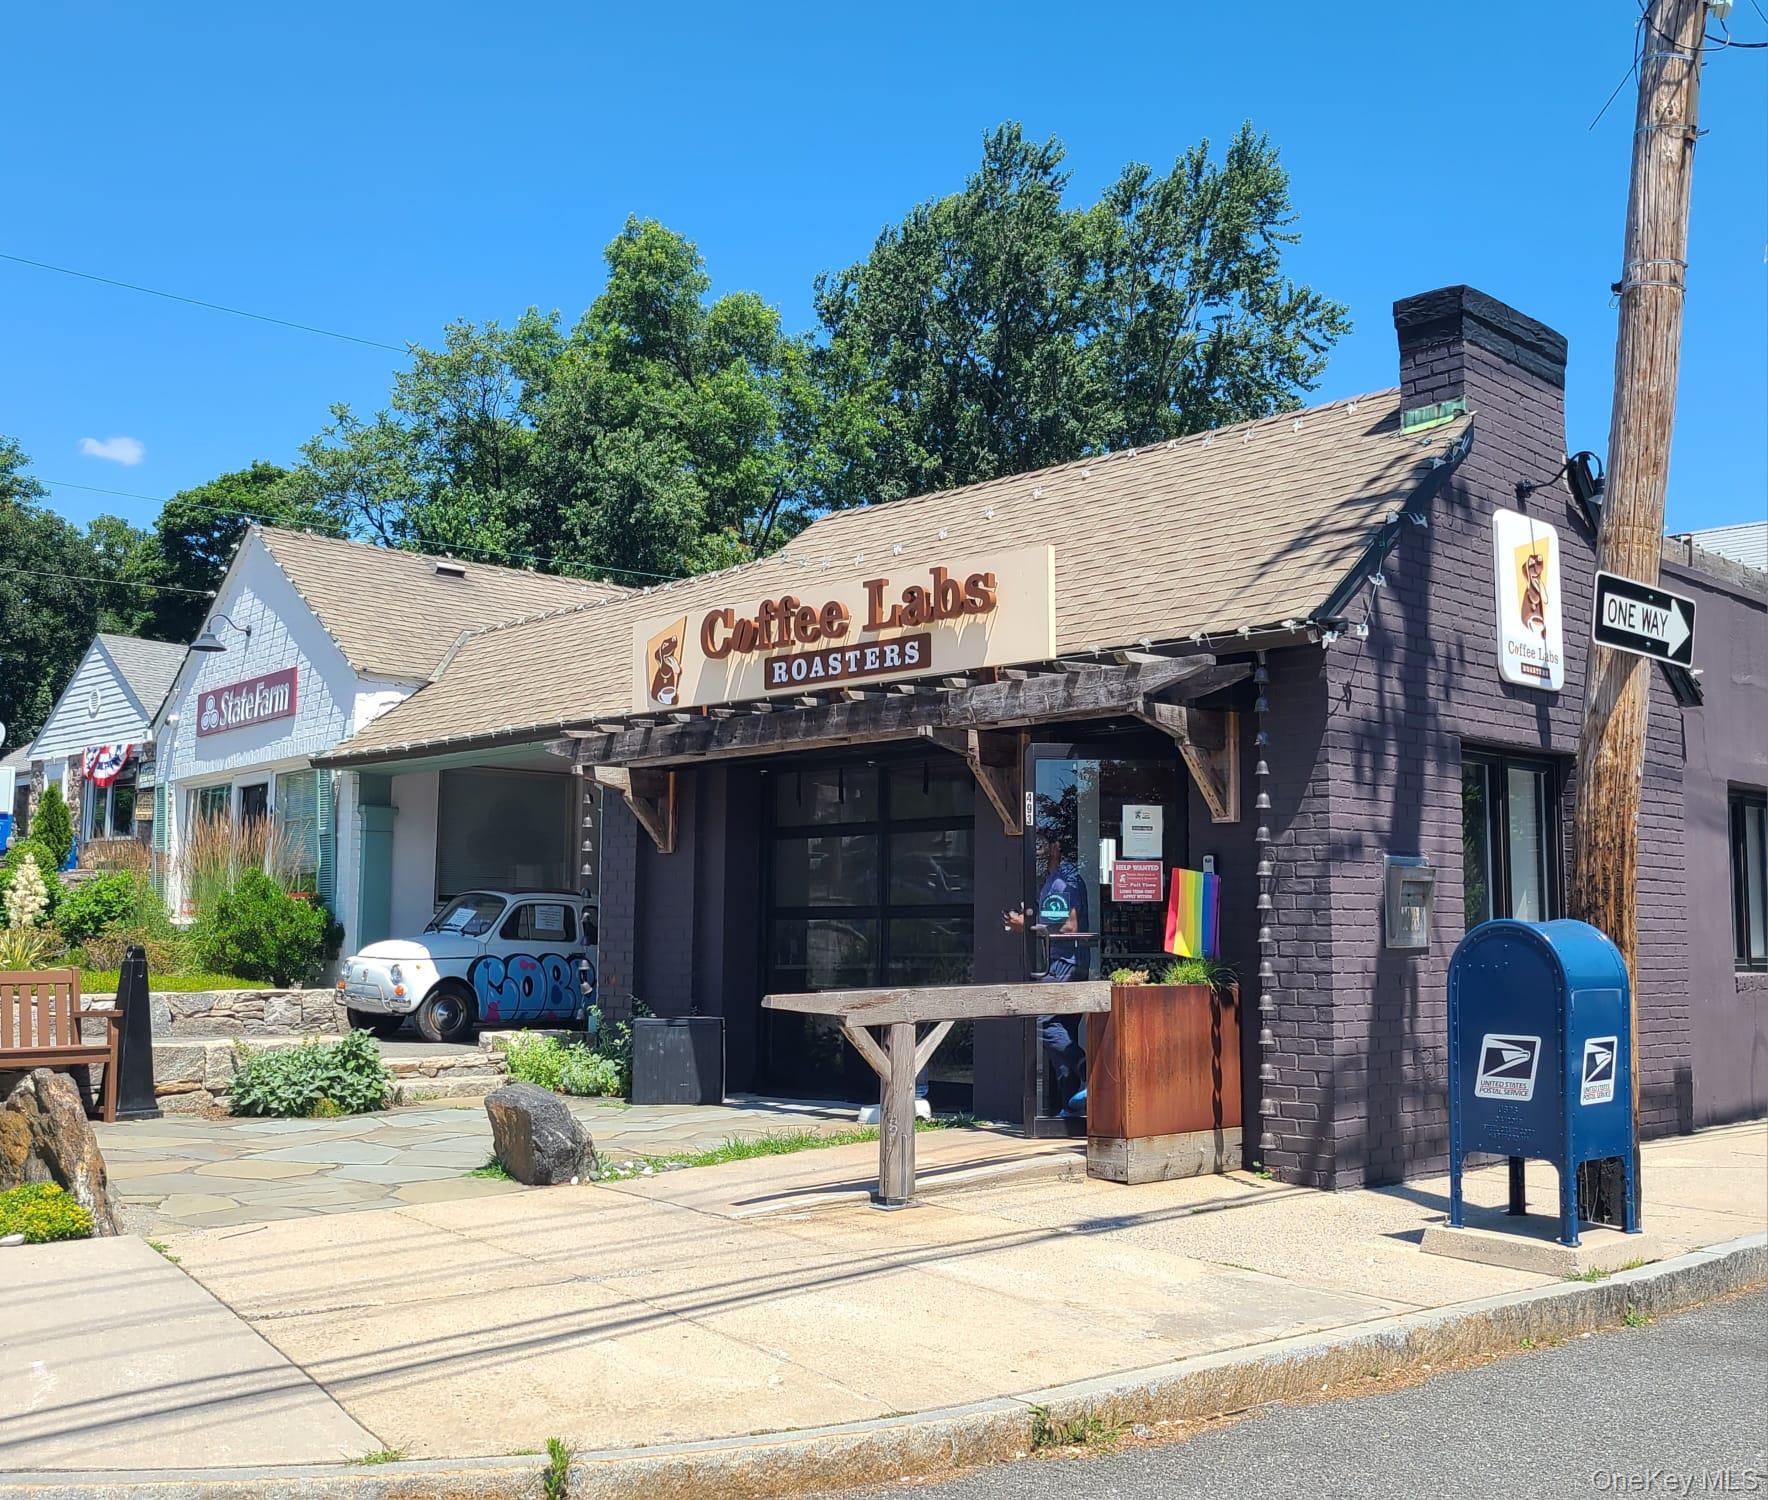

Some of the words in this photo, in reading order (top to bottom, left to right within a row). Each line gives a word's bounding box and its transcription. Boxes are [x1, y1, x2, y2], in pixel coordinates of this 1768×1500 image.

[700, 596, 851, 660] Coffee
[862, 566, 998, 633] Labs
[1607, 598, 1637, 630] ONE
[1641, 606, 1669, 638] WAY
[771, 639, 921, 685] ROASTERS
[1507, 640, 1537, 660] Coffee
[1479, 1087, 1503, 1096] POSTAL
[1503, 1088, 1530, 1097] SERVICE
[1480, 1080, 1504, 1089] UNITED
[1504, 1081, 1528, 1090] STATES
